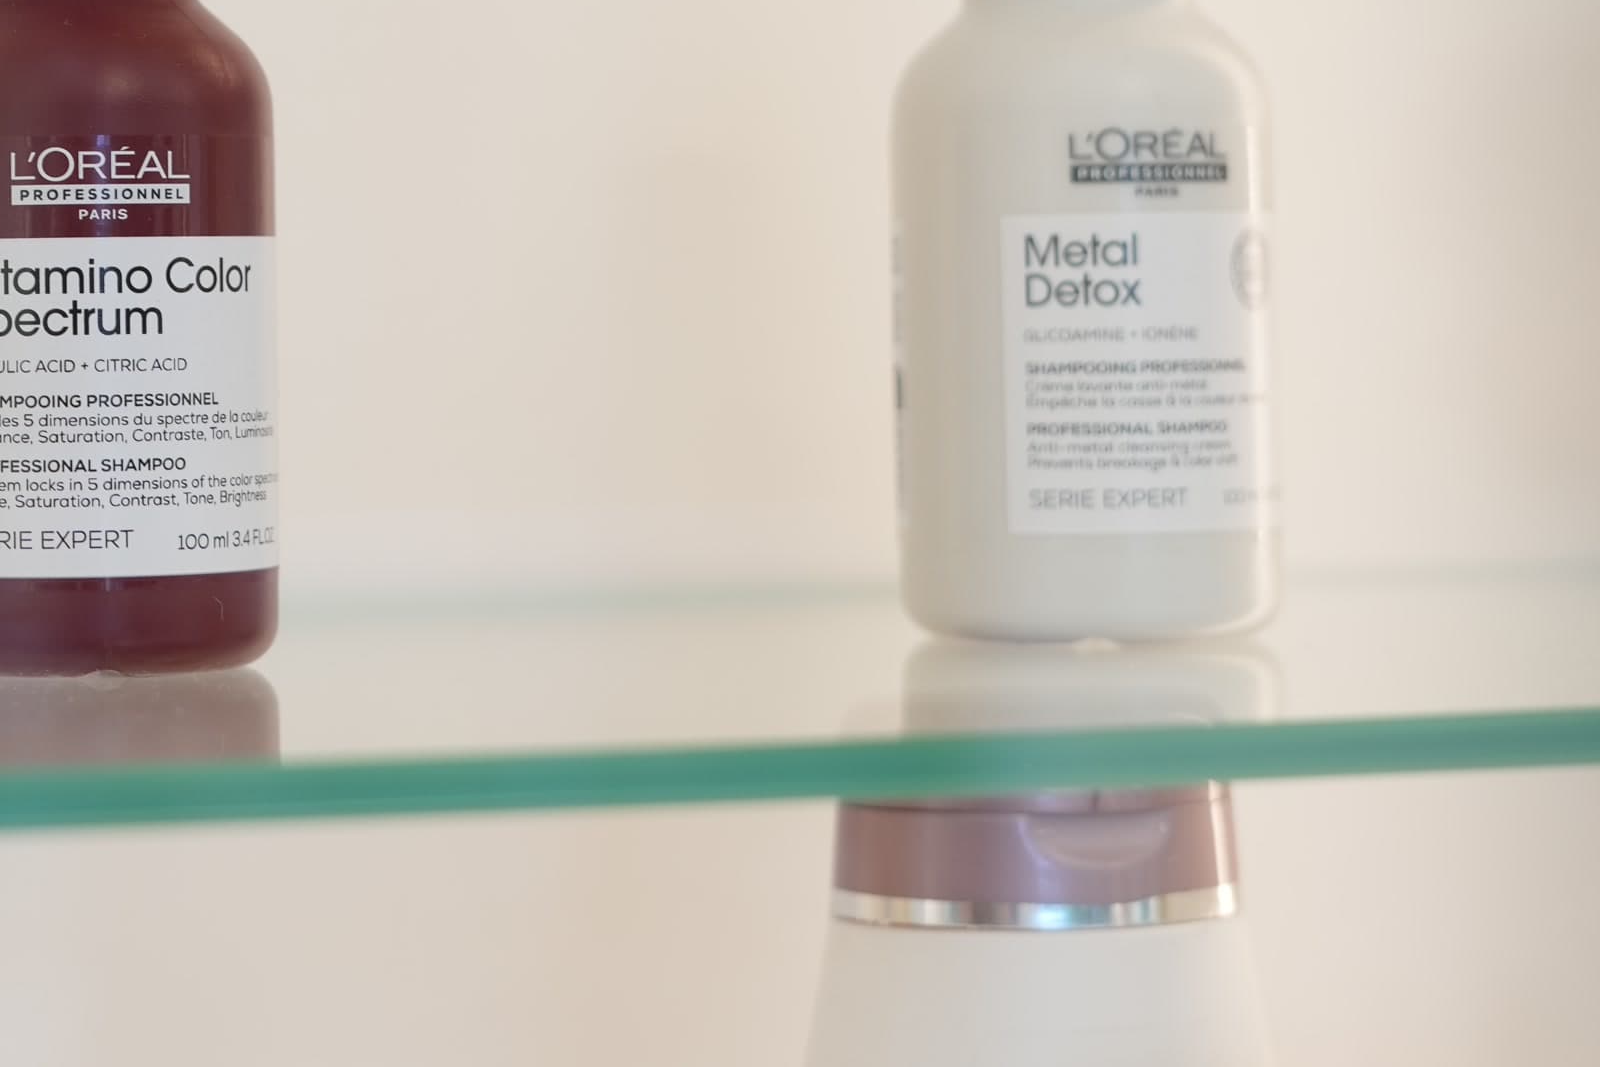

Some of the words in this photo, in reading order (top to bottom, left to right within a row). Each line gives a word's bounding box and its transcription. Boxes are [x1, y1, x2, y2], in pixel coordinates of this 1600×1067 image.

[1068, 127, 1227, 161] L'ORÉAL
[10, 147, 191, 182] L'ORÉAL
[1077, 165, 1223, 181] PROFESSIONNEL
[20, 188, 184, 202] PROFESSIONNEL
[1134, 186, 1179, 197] PARIS
[78, 208, 129, 221] PARIS
[1024, 233, 1138, 268] Metal
[165, 256, 251, 293] Color
[1024, 273, 1142, 308] Detox
[35, 359, 76, 373] ACID
[94, 358, 147, 372] CITRIC
[151, 357, 188, 372] ACID
[1025, 360, 1137, 375] SHAMPOOING
[86, 392, 219, 408] PROFESSIONNEL
[0, 414, 19, 427] les
[23, 414, 34, 427] 5
[38, 413, 129, 427] dimensions
[133, 413, 153, 426] du
[157, 412, 209, 428] spectre
[212, 410, 227, 423] de
[229, 410, 239, 423] la
[1026, 421, 1152, 436] PROFESSIONAL
[1157, 419, 1228, 434] SHAMPOO
[38, 430, 128, 444] Saturation,
[132, 428, 207, 442] Contraste,
[210, 426, 233, 440] Ton,
[101, 457, 186, 472] SHAMPOO
[26, 478, 65, 492] locks
[69, 478, 83, 491] in
[88, 477, 98, 491] 5
[103, 477, 188, 491] dimensions
[191, 475, 205, 488] of
[208, 474, 227, 488] the
[229, 473, 252, 487] color
[15, 495, 105, 509] Saturation,
[109, 493, 180, 507] Contrast,
[184, 491, 217, 505] Tone,
[220, 489, 267, 507] Brightness
[1028, 488, 1096, 510] SERIE
[1103, 487, 1188, 510] EXPERT
[41, 529, 134, 550] EXPERT
[178, 533, 210, 551] 100
[213, 530, 229, 548] ml
[232, 529, 251, 547] 3.4
